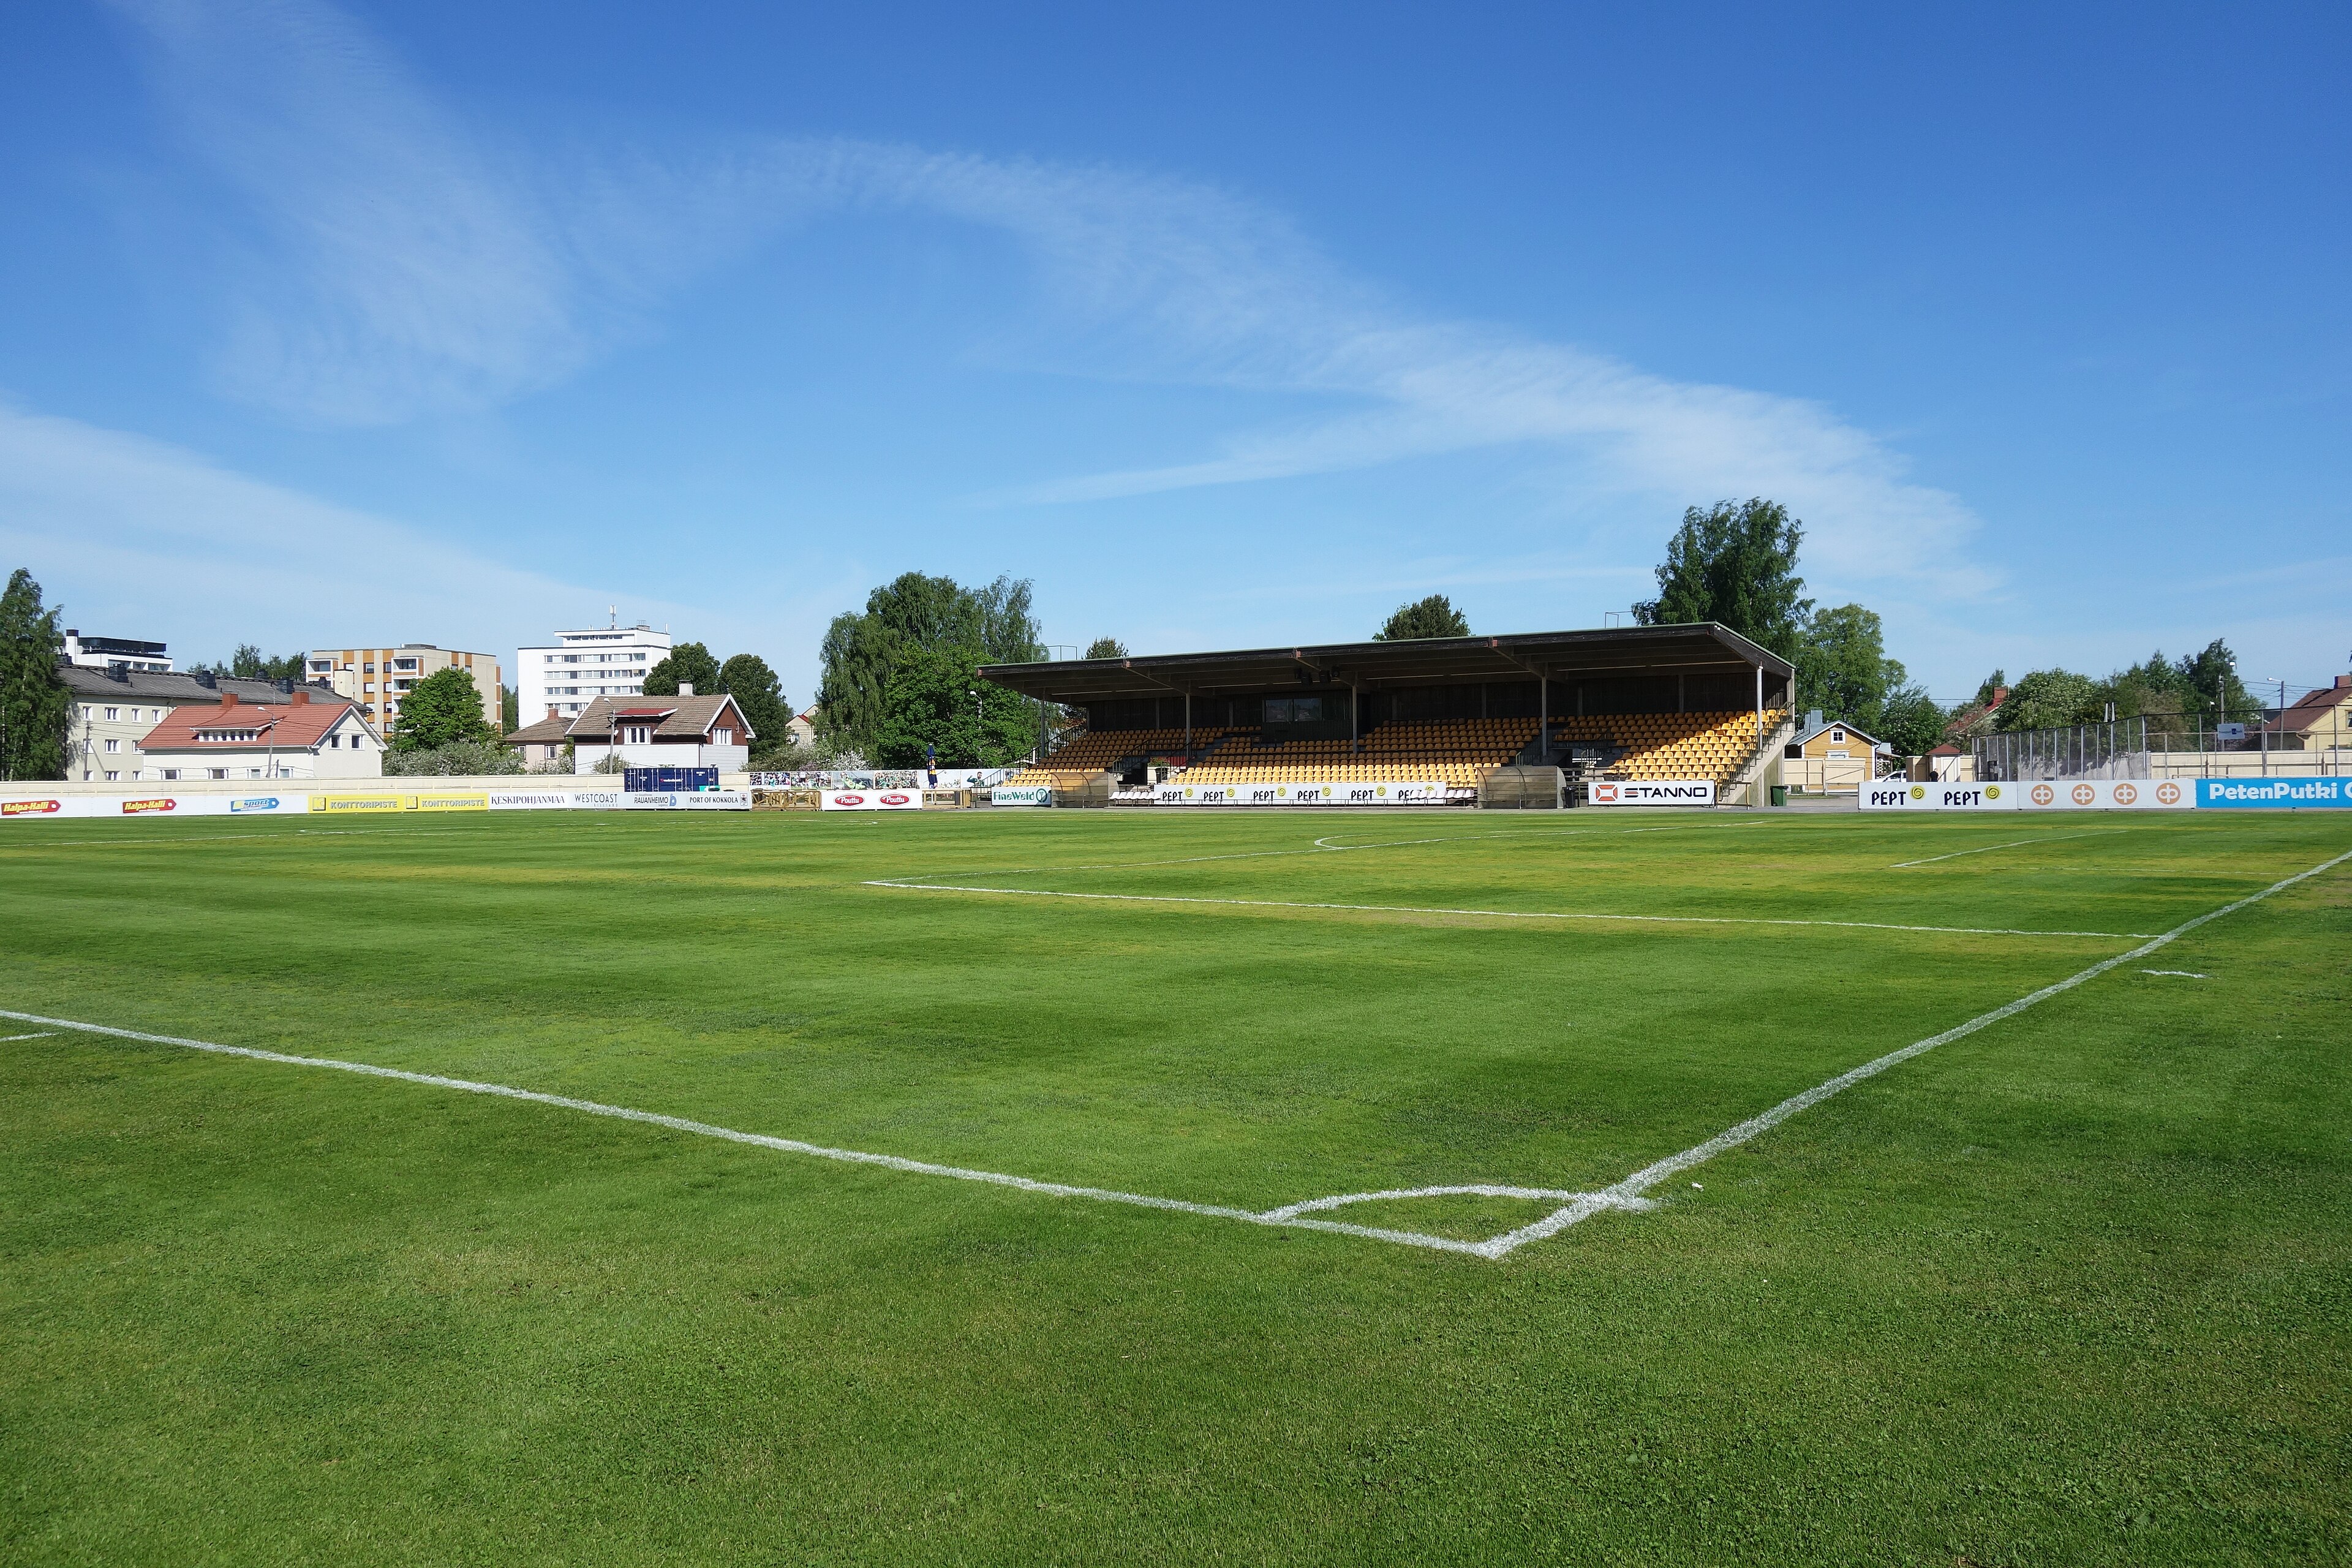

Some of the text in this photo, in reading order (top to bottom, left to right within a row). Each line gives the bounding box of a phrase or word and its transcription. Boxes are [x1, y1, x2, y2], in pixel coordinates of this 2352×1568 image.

[993, 791, 1035, 801] FineWeld
[1163, 791, 1183, 801] PEPT
[1204, 791, 1224, 801] PEPT
[1254, 791, 1275, 801] PEPT
[1298, 790, 1319, 801] PEPT
[1351, 790, 1374, 801] PEPT
[1624, 787, 1707, 798] STANNO
[2209, 782, 2337, 800] PetenPutki
[491, 796, 565, 805] KESKIPOHJANMAA
[575, 794, 617, 803] WESTCOAST
[1871, 791, 1906, 805] PEPT
[1944, 791, 1980, 805] PEPT
[4, 802, 49, 812] Halpa-Halli
[125, 801, 165, 810] Halpa-Halli
